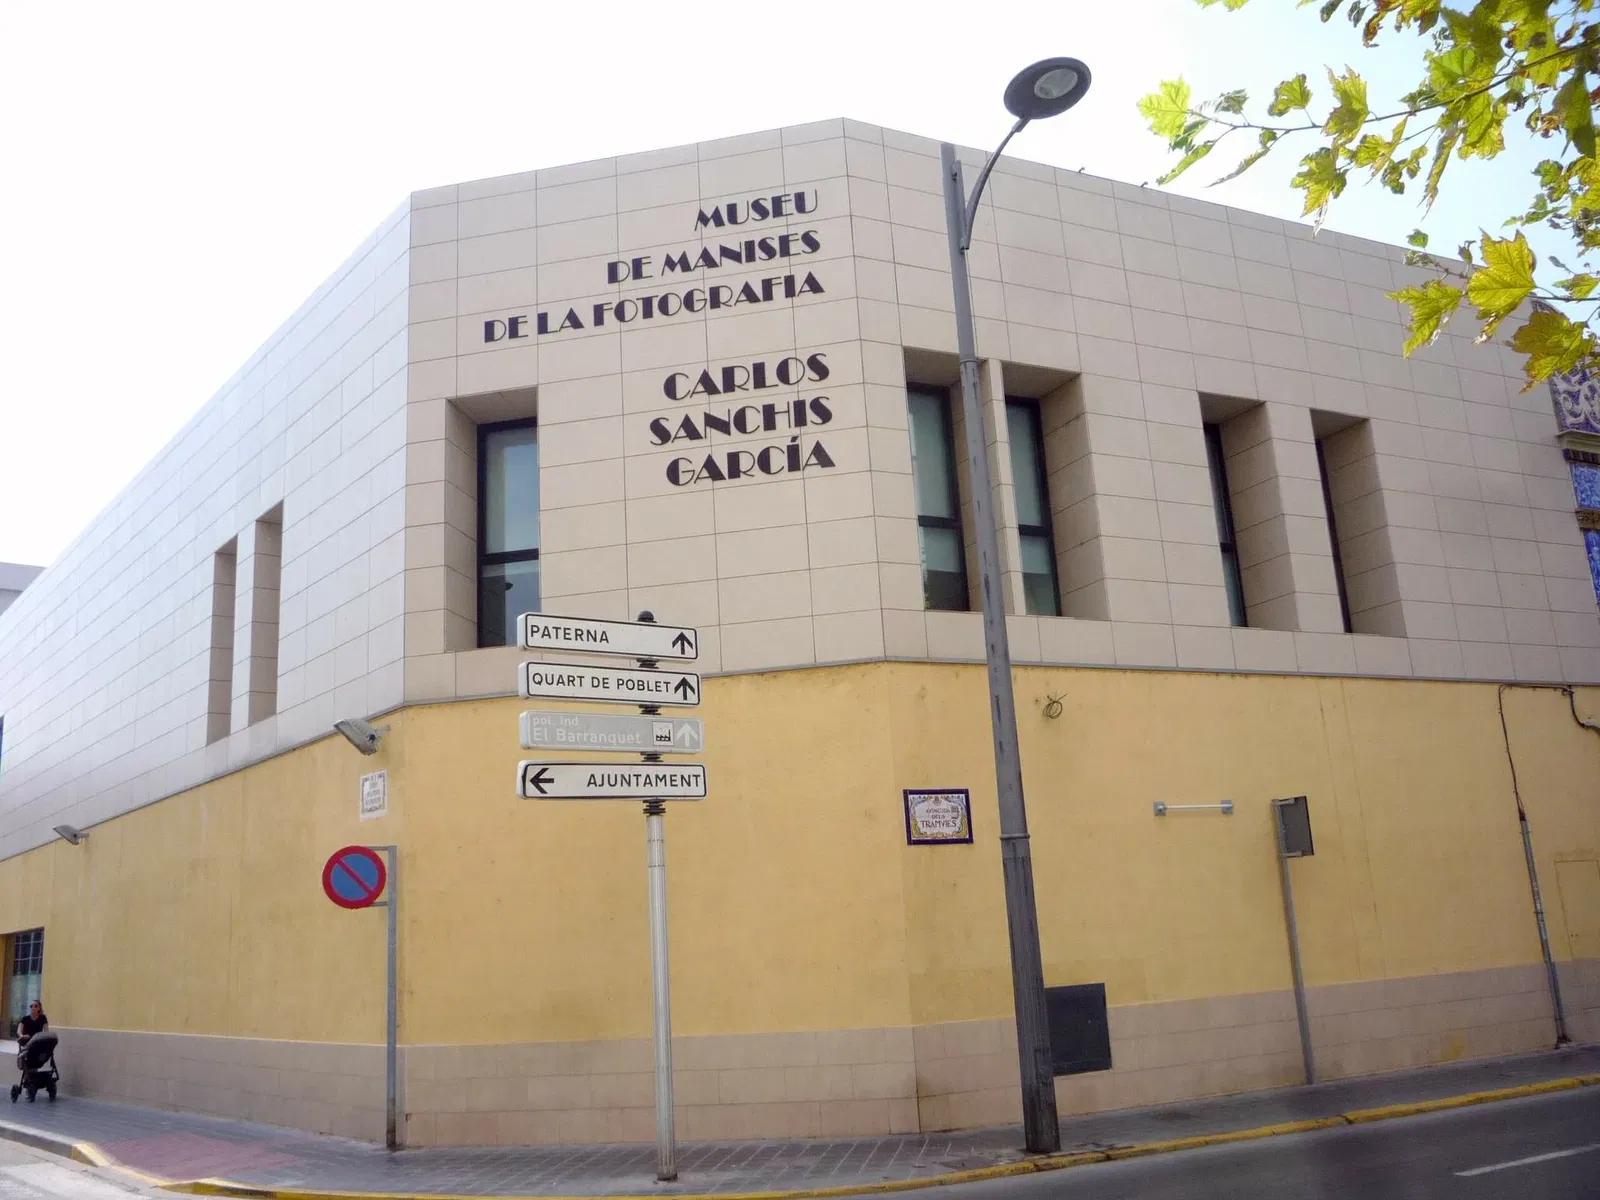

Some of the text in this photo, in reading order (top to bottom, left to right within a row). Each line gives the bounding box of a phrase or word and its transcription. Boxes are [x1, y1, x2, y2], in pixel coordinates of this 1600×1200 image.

[695, 189, 818, 231] MUSEU
[607, 230, 821, 284] DE MANISES
[484, 271, 825, 343] DE LA FOTOGRAFIA
[663, 353, 830, 401] CARLOS
[649, 396, 833, 446] SANCHIS
[666, 436, 836, 486] GARCÍA
[530, 624, 610, 644] PATERNA
[532, 672, 671, 693] QUART DE POBLET
[533, 727, 642, 745] El Barranquet
[586, 773, 701, 788] AJUNTAMENT
